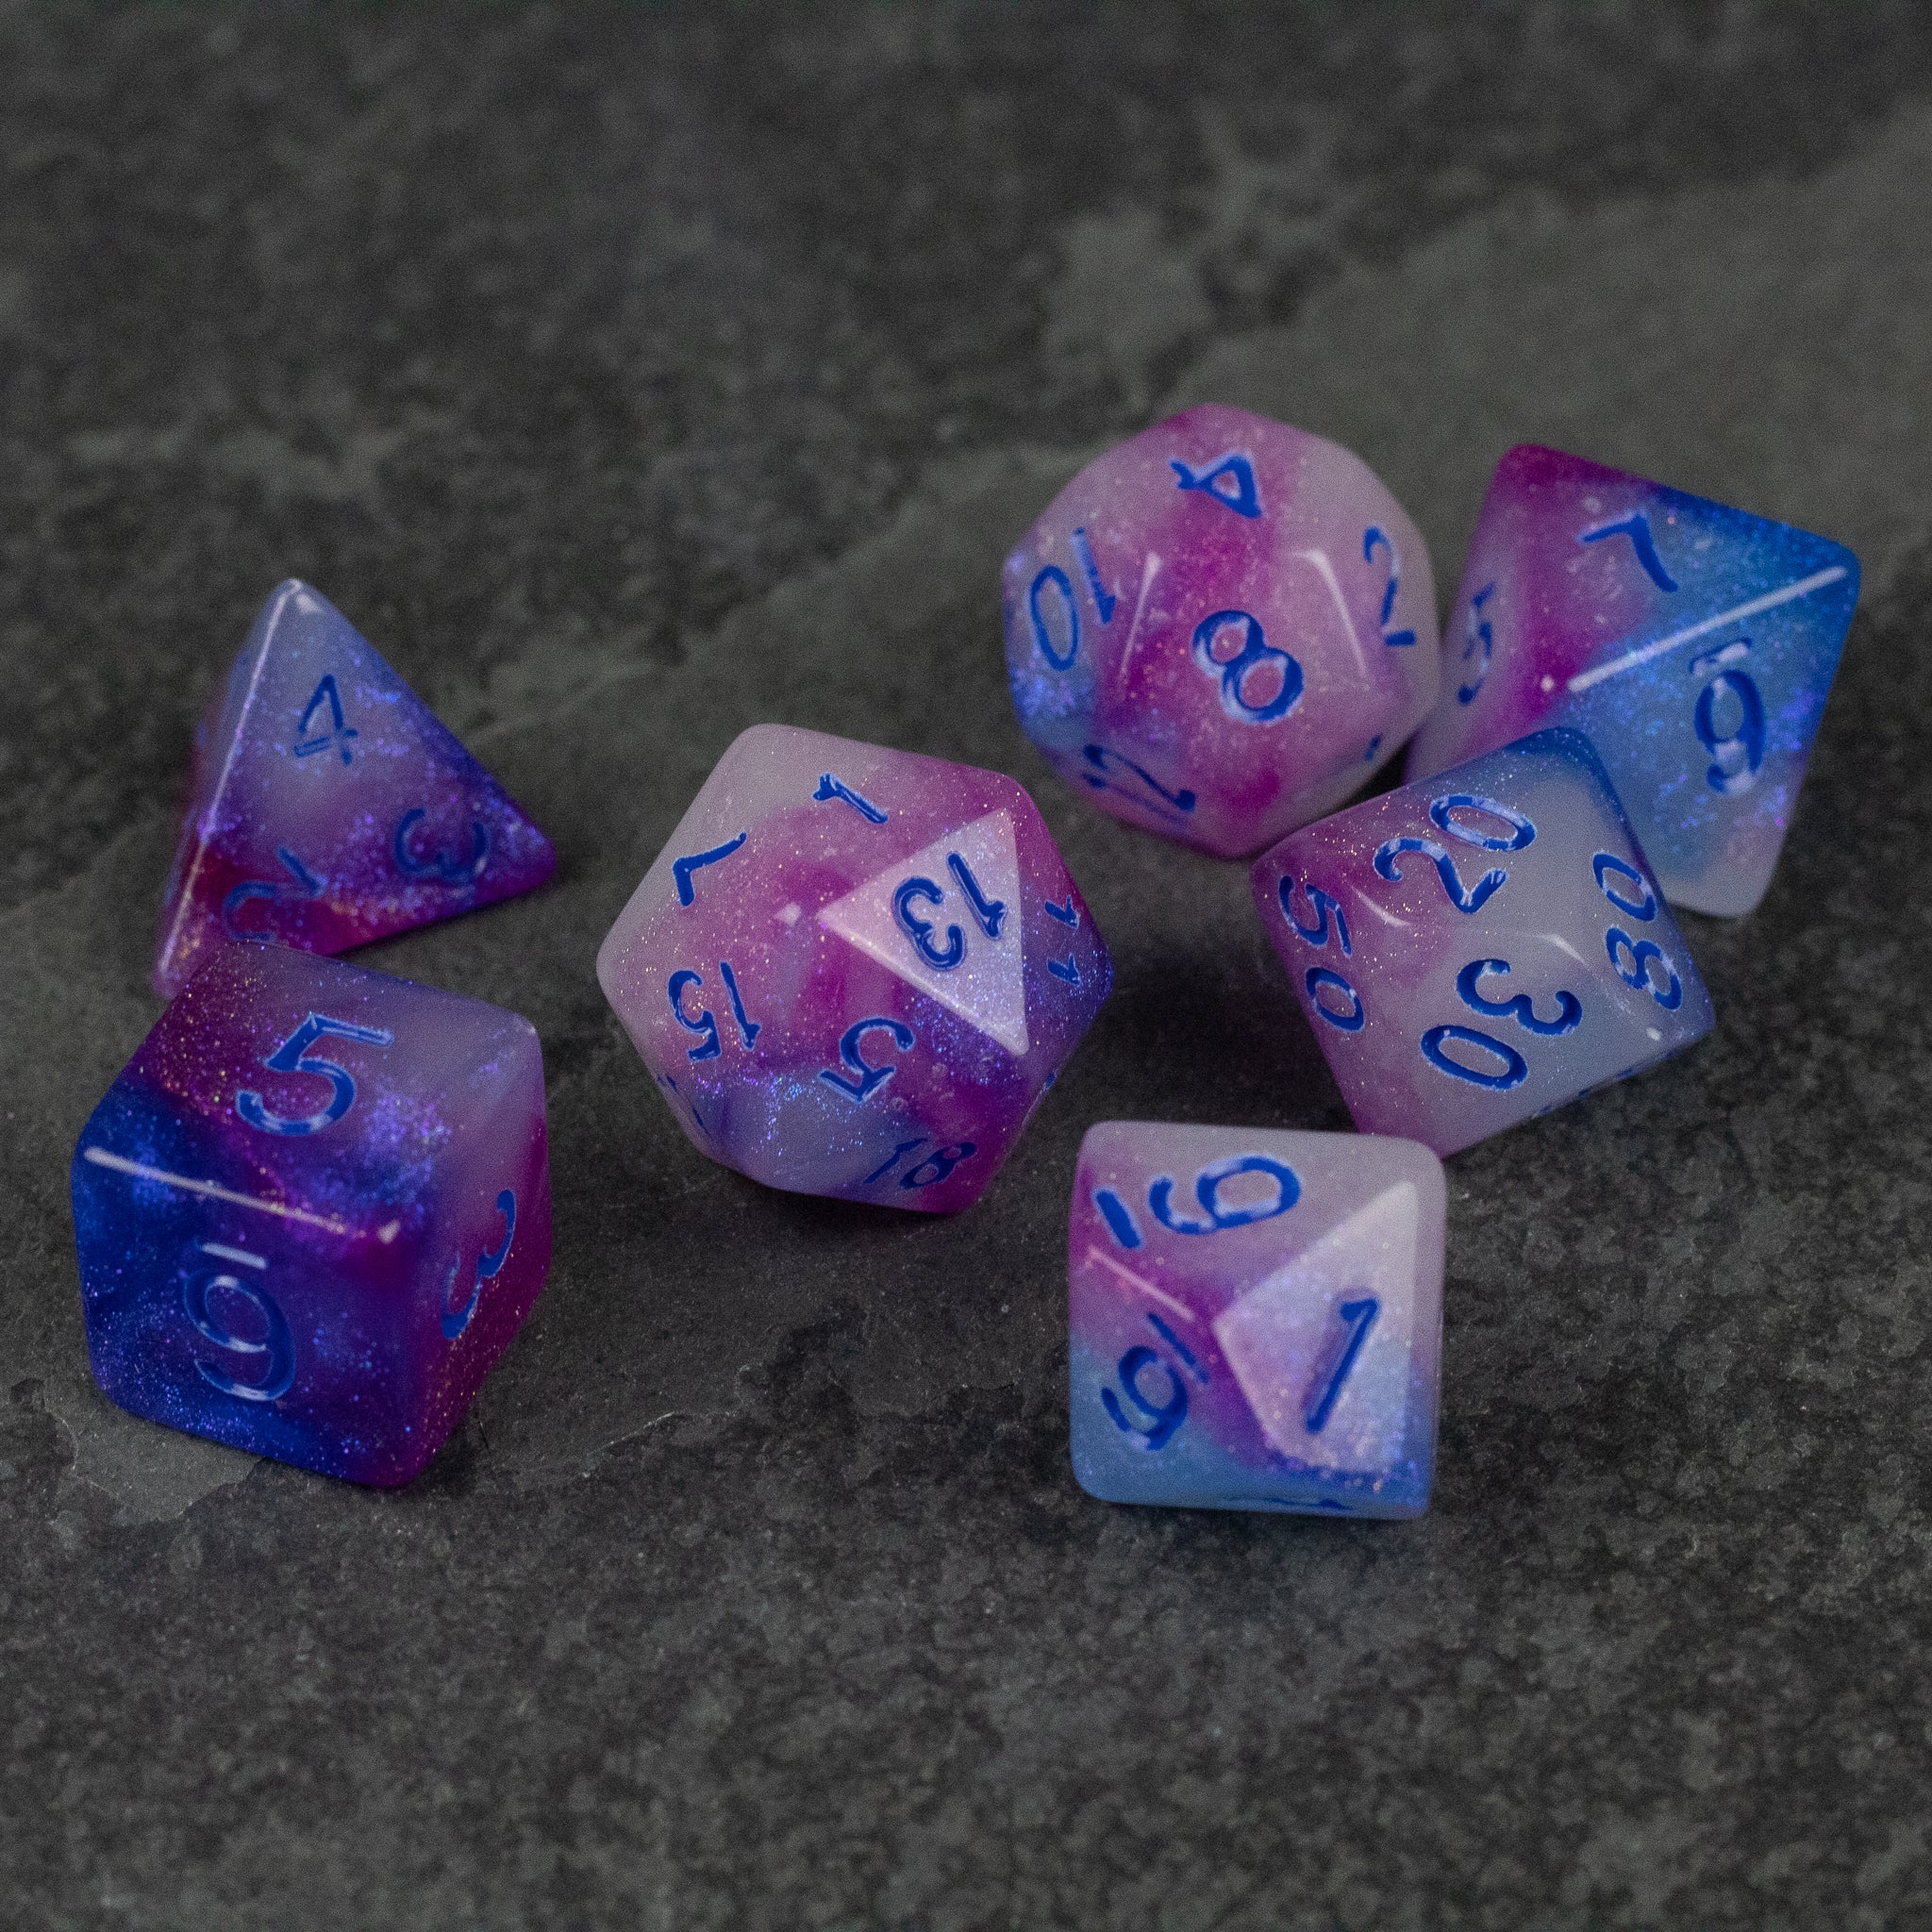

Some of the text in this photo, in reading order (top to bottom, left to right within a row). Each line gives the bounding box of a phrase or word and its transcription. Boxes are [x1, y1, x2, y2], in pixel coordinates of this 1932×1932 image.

[1167, 451, 1263, 520] 4
[1028, 526, 1117, 673] 10
[1364, 523, 1416, 647] 2
[1574, 509, 1678, 593] 7
[293, 674, 358, 766] 4
[1191, 608, 1306, 726] 8
[394, 807, 490, 889] 3
[812, 773, 890, 824] 1
[1374, 793, 1539, 914] 20
[891, 851, 1008, 971] 13
[1277, 874, 1365, 1034] 50
[1592, 851, 1684, 1012] 80
[667, 960, 762, 1063] 15
[818, 1016, 915, 1106] 5
[1419, 958, 1584, 1091] 30
[234, 1012, 395, 1138] 5
[862, 1137, 978, 1191] 18
[440, 1189, 518, 1341] 3
